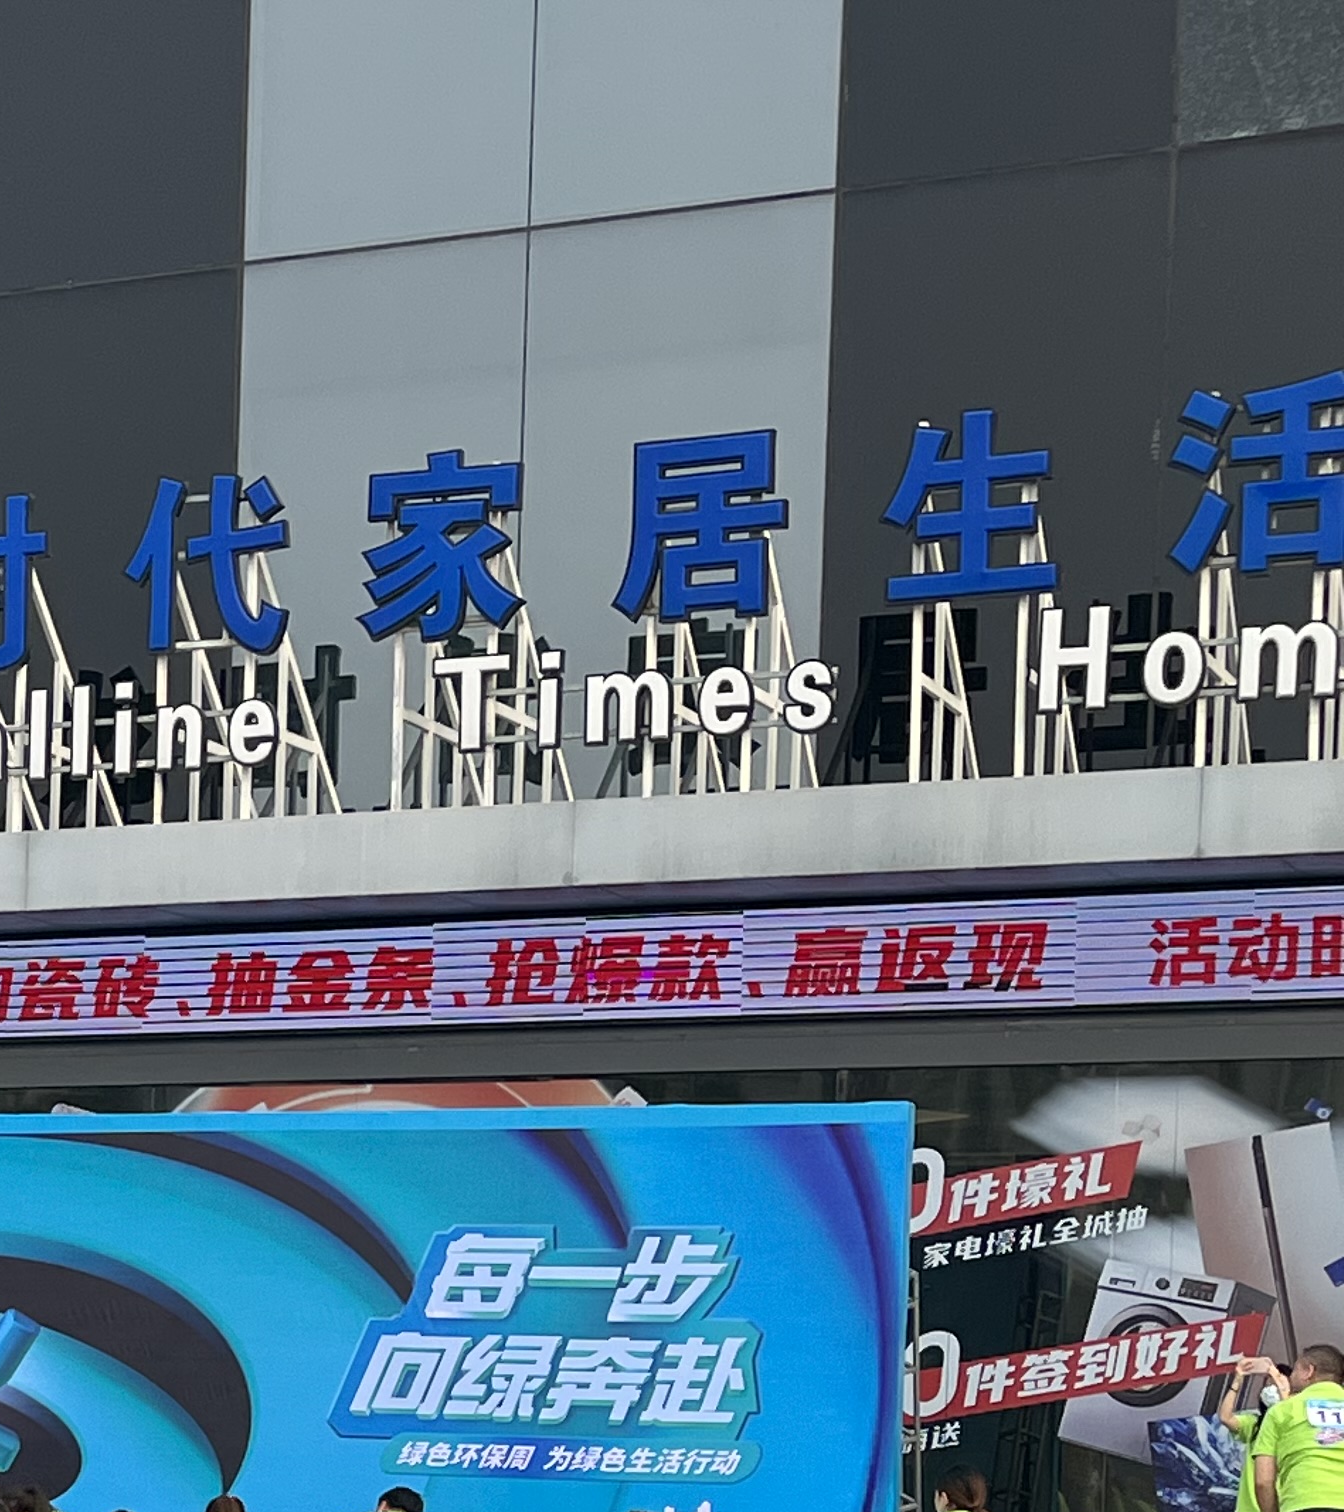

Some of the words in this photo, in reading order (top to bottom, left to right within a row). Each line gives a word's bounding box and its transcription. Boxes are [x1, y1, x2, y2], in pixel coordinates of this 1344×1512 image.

[434, 648, 838, 754] Times
[423, 1232, 727, 1324] 每一步
[348, 1331, 749, 1426] 向绿奔赴
[395, 1440, 537, 1473] 绿色环保周
[543, 1446, 742, 1476] 为绿色生活行动
